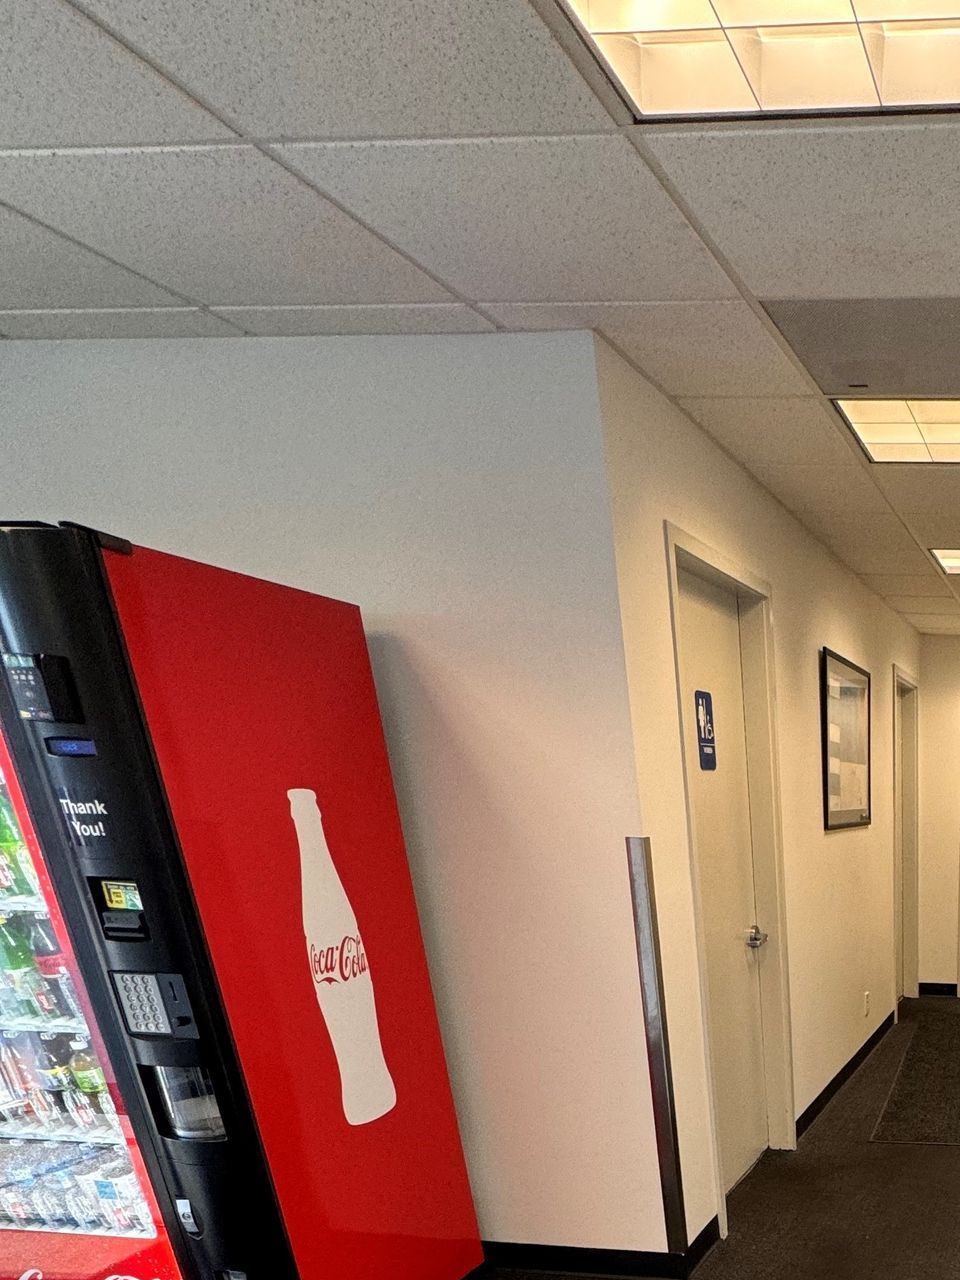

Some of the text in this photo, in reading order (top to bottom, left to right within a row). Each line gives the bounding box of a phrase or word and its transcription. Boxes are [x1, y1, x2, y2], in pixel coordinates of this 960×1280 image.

[59, 799, 108, 815] Thank
[71, 821, 106, 836] You!
[310, 935, 367, 985] Coca-Cola
